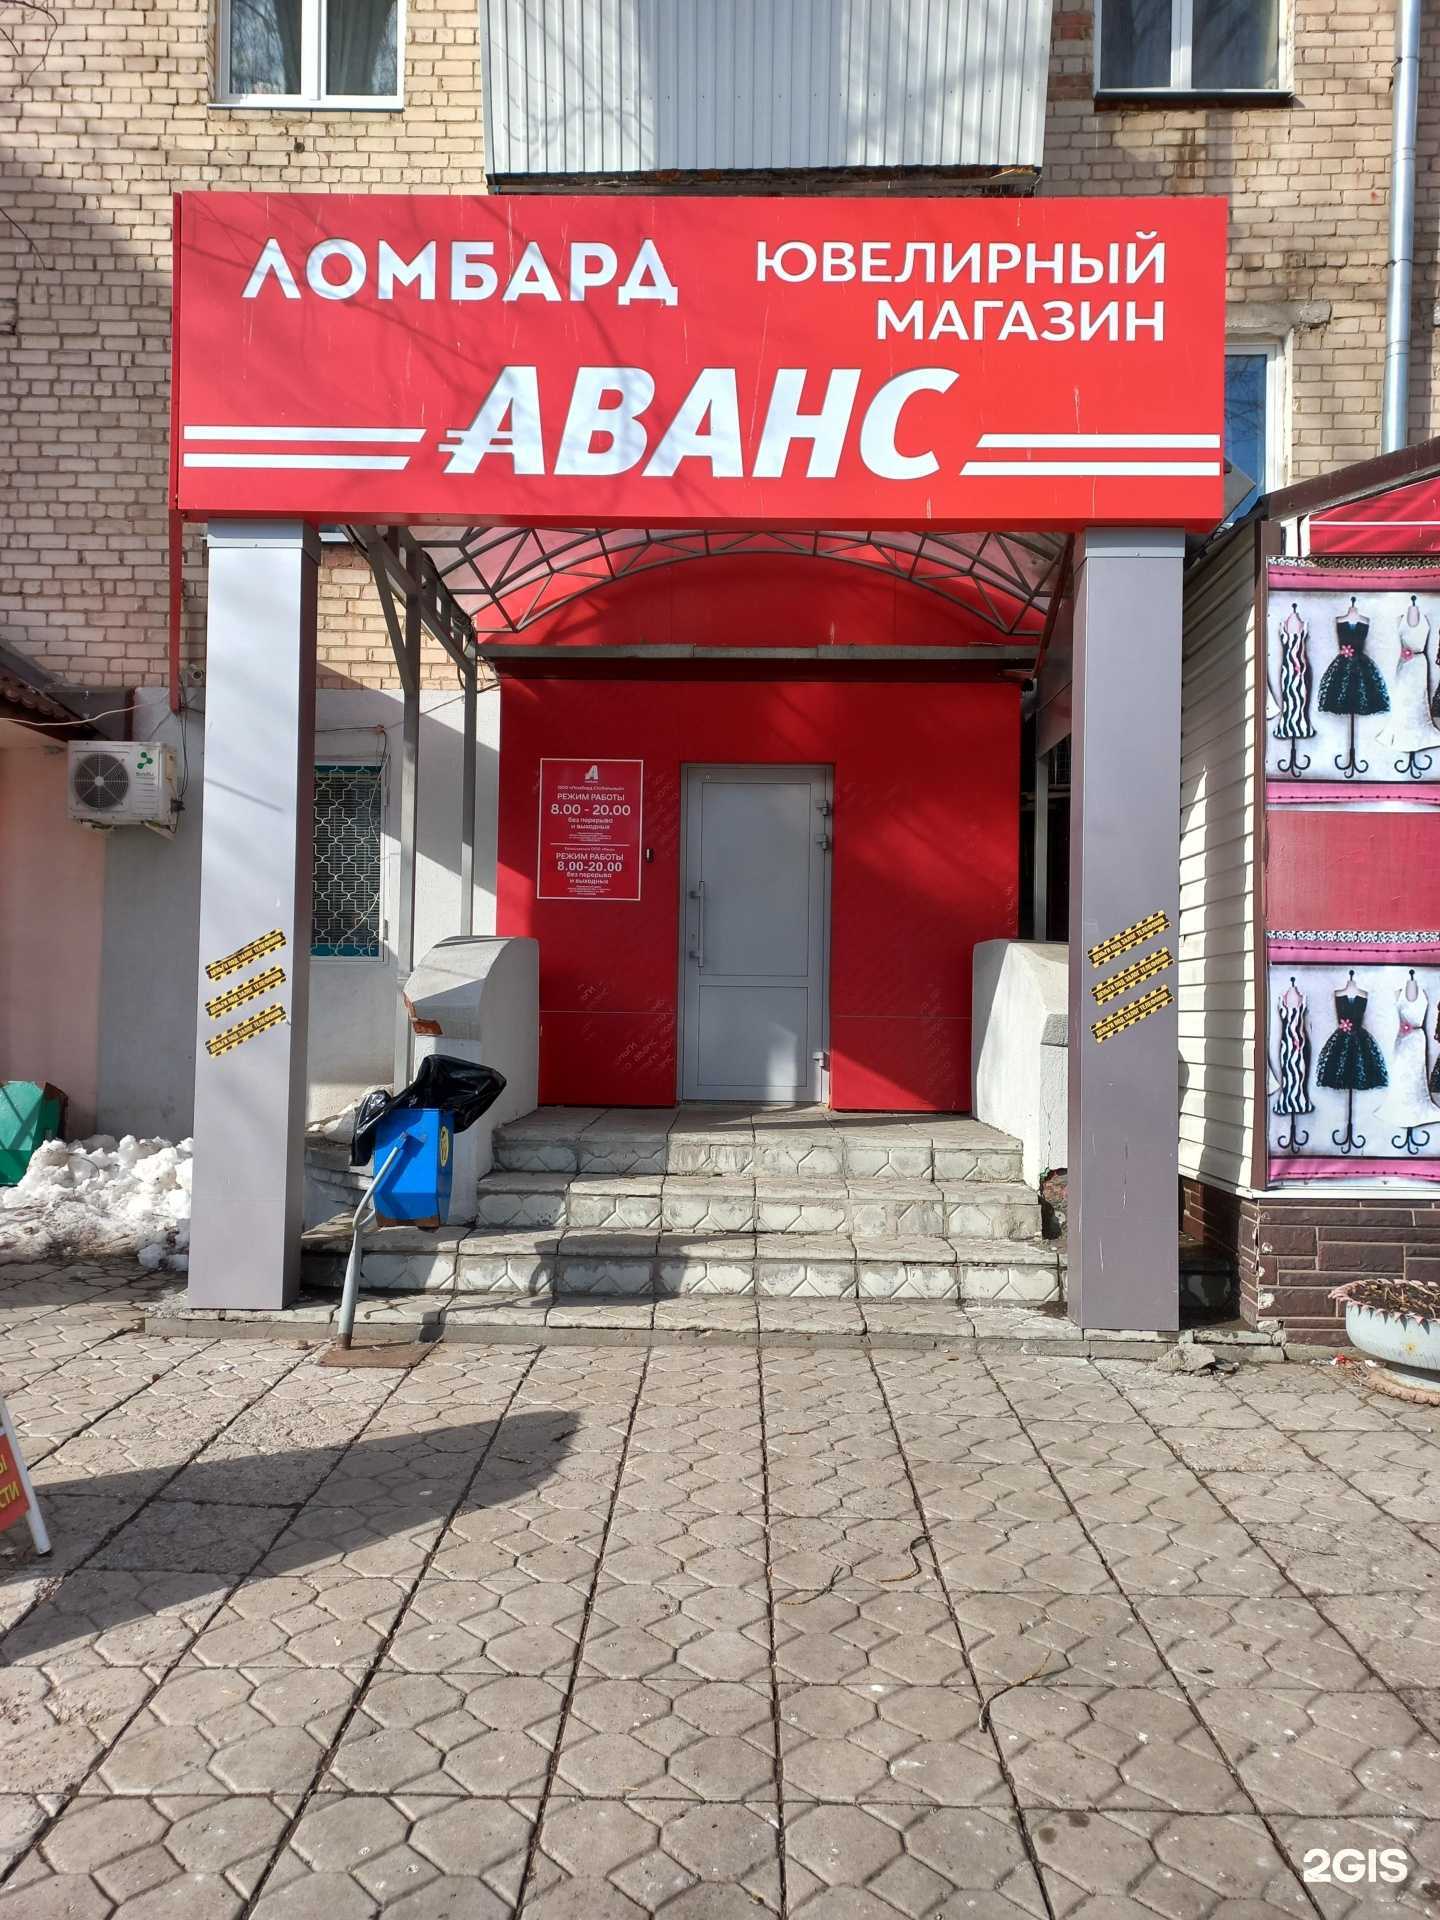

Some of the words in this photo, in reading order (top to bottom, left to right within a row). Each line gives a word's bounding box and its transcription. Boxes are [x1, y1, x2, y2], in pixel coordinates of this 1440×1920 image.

[756, 231, 1166, 284] ЮВЕЛИРНЫЙ
[242, 238, 679, 306] ЛОМБАРД
[877, 299, 1165, 342] МАГАЗИН
[438, 365, 960, 480] АВАНС
[550, 803, 581, 815] 8.00
[592, 804, 631, 816] 20.00
[557, 793, 590, 801] РЕЖИМ
[591, 793, 625, 801] РАБОТЫ
[556, 852, 588, 861] РЕЖИМ
[589, 853, 624, 861] РАБОТЫ
[557, 861, 622, 872] 8.00-20.00
